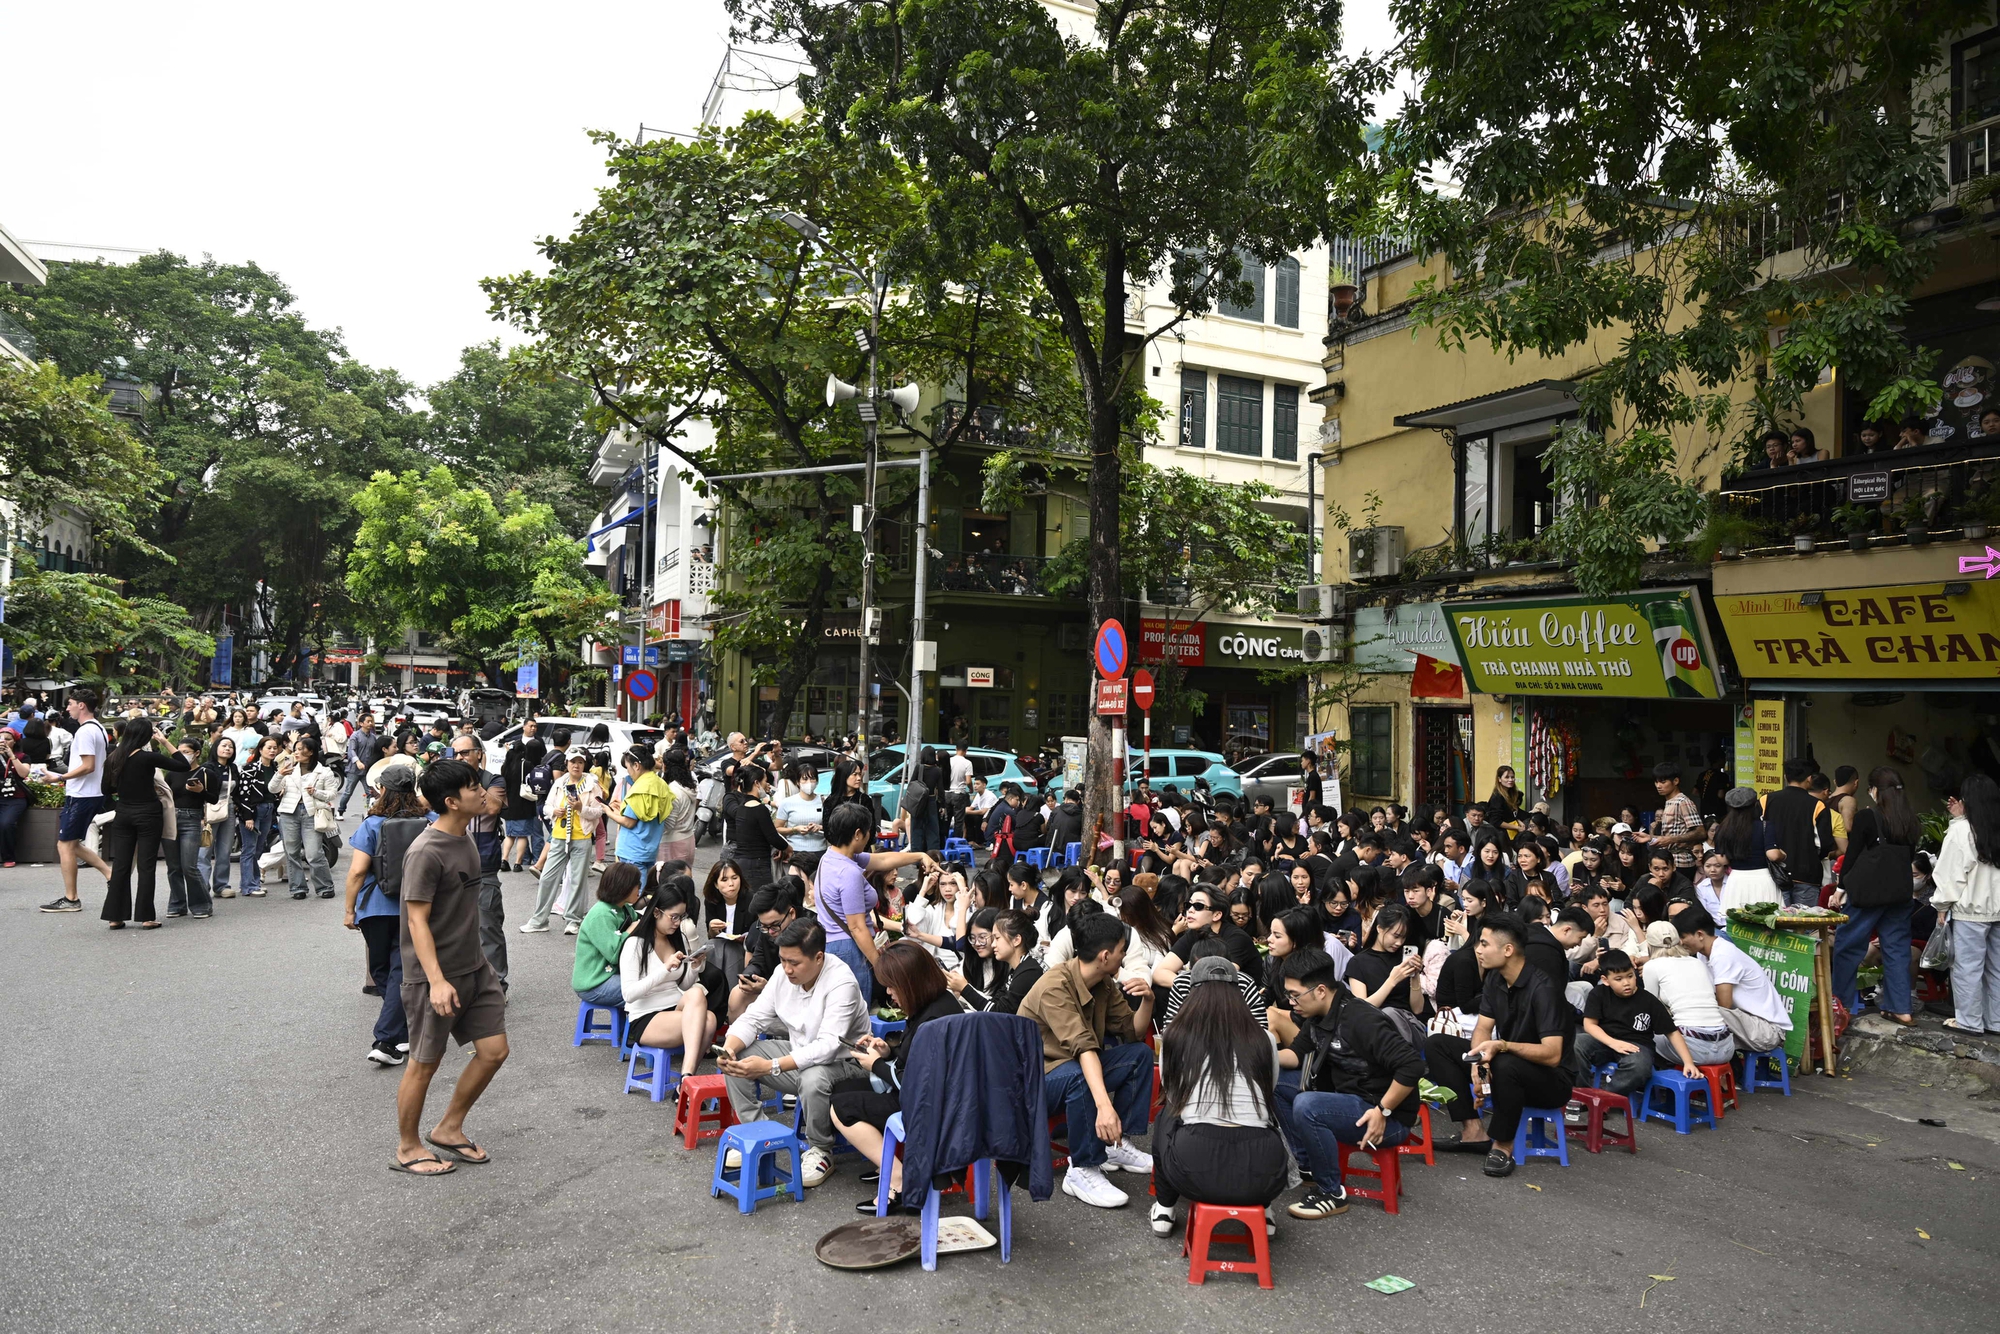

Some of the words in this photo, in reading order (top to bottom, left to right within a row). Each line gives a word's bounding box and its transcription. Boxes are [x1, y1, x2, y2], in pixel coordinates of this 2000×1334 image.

[1943, 366, 1974, 388] Coffee
[1729, 600, 1773, 613] Minh
[1821, 594, 1956, 627] CAFE
[1459, 614, 1534, 649] Hiếu
[1538, 609, 1642, 654] Coffee
[1143, 631, 1200, 645] PROPGNDA
[1219, 632, 1277, 661] CỘNG
[1753, 631, 1852, 667] TRÀ
[626, 653, 637, 662] NHÀ
[637, 655, 655, 663] CUNG
[1480, 658, 1509, 677] TRÀ
[1510, 661, 1561, 677] CHANH
[1563, 657, 1594, 678] NHÀ
[1597, 658, 1633, 678] THỜ
[1102, 685, 1112, 694] KHU
[1514, 681, 1528, 690] ĐỊA
[1544, 679, 1554, 690] SỐ
[1554, 682, 1560, 690] 2
[1560, 681, 1577, 690] NHÀ
[1577, 682, 1604, 691] CHUNG
[1117, 700, 1125, 709] XE
[1761, 709, 1776, 718] COFFEE
[1757, 723, 1772, 731] LEMON
[1772, 723, 1780, 731] TEA
[1760, 736, 1777, 745] TAPIOCA
[1758, 749, 1778, 758] STARLING
[1759, 762, 1777, 771] APRICOT
[1755, 775, 1766, 784] SALT
[1766, 776, 1780, 784] LEMON
[1755, 933, 1780, 946] Minh
[1748, 945, 1787, 963] CHUYÊN:
[1780, 967, 1809, 993] CỐM
[1632, 1012, 1651, 1031] NY
[1786, 1057, 1793, 1065] 6
[1353, 1188, 1368, 1197] 24
[1220, 1262, 1234, 1271] 24
